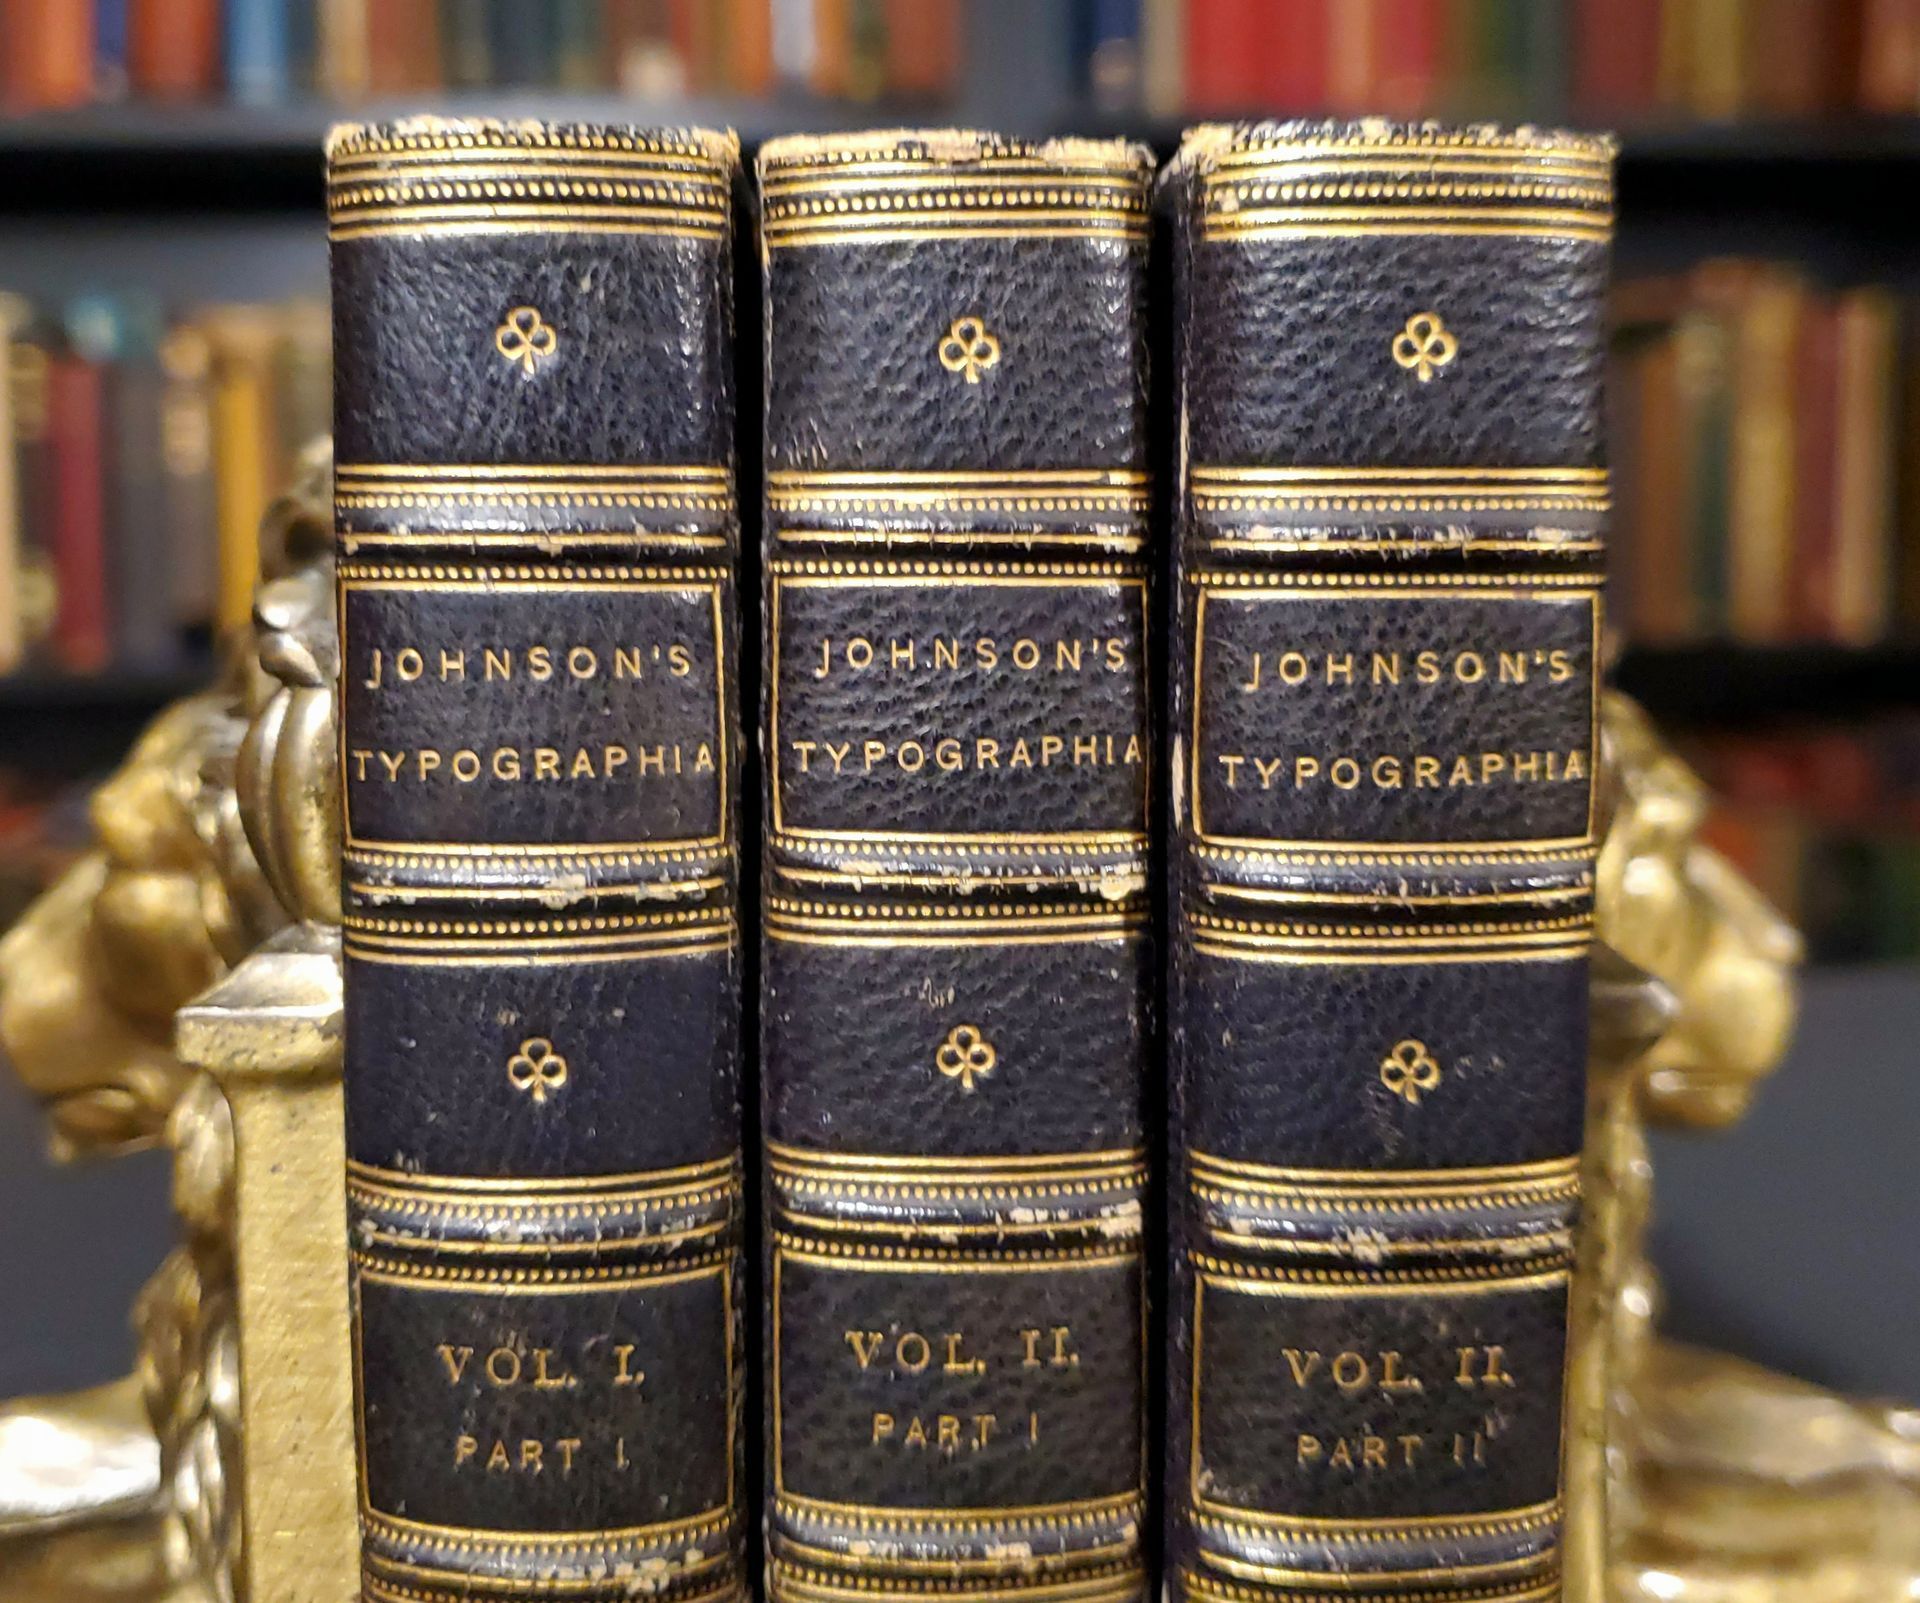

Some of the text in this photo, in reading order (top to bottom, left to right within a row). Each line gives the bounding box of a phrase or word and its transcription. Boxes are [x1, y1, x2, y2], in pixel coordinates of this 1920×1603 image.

[365, 644, 691, 690] JOHNSON'S
[814, 637, 1127, 679] JOHNSON'S
[1243, 648, 1575, 693] JOHNSON'S
[351, 742, 716, 783] TYPOGRAPHIA
[792, 734, 1143, 774] TYPOGRAPHIA
[1218, 749, 1588, 790] TYPOGRAPHIA
[436, 1342, 645, 1389] VOL. I.
[844, 1326, 1080, 1376] VOL. II.
[1281, 1347, 1424, 1391] VOL.
[871, 1410, 1040, 1450] PART I
[1297, 1431, 1486, 1470] PART II
[454, 1434, 582, 1474] PART
